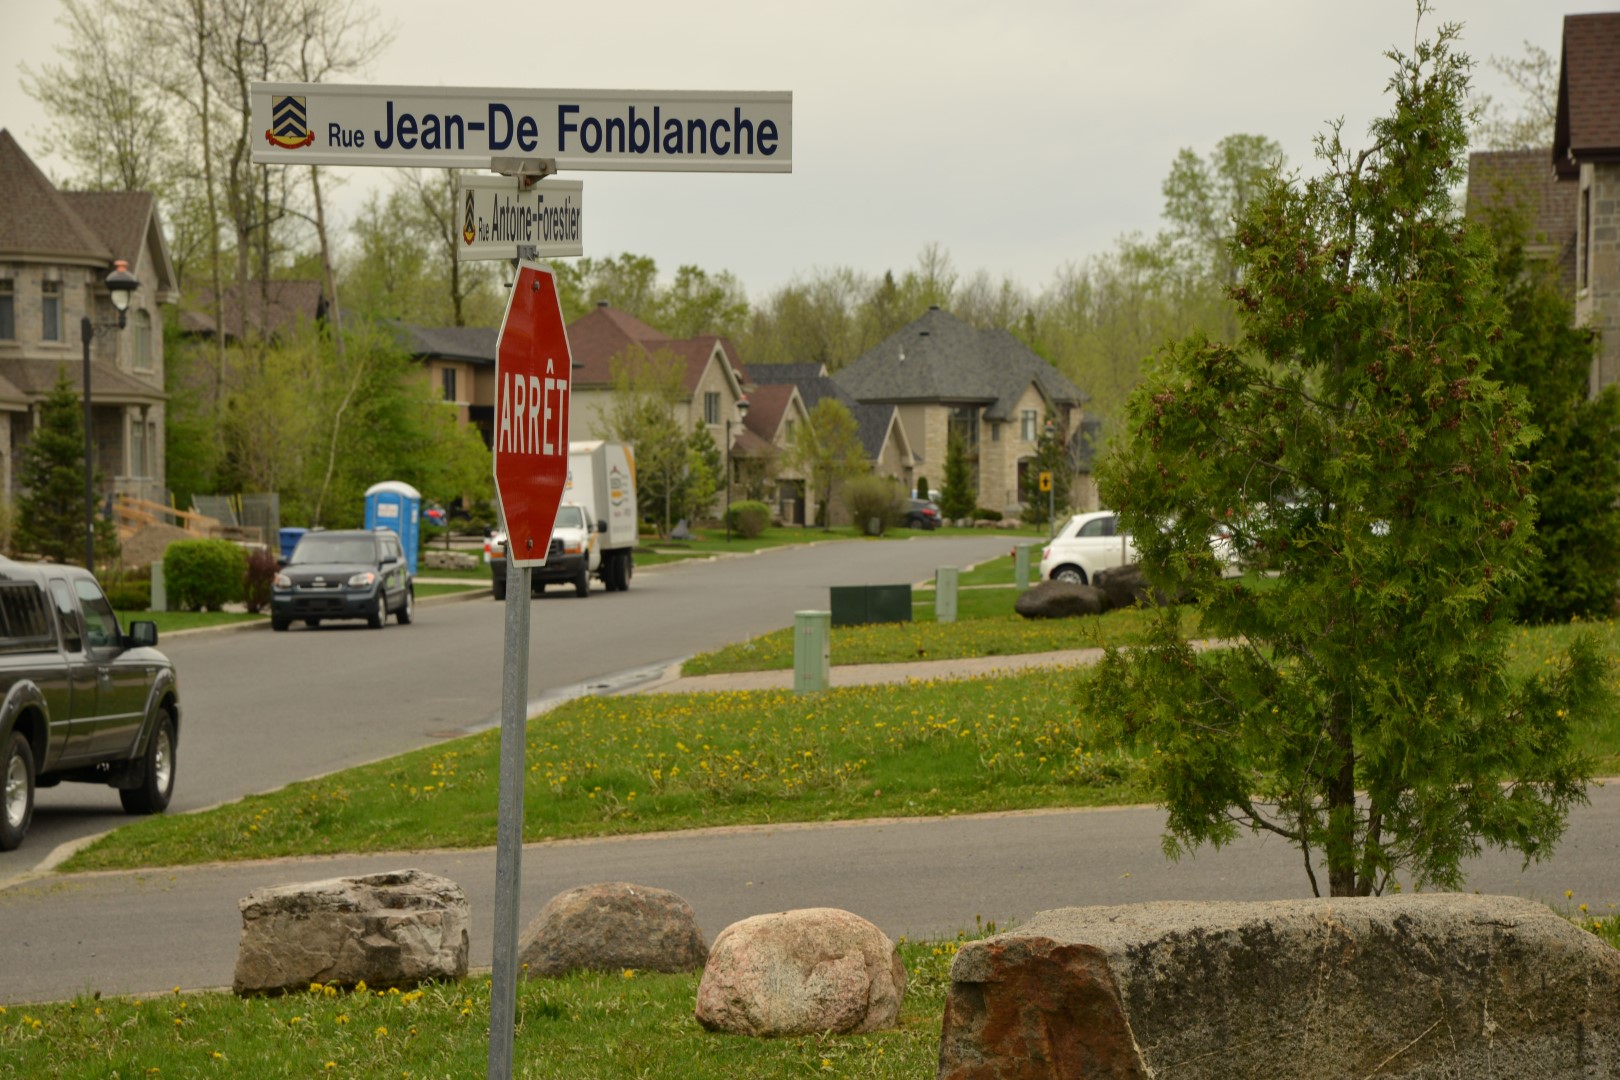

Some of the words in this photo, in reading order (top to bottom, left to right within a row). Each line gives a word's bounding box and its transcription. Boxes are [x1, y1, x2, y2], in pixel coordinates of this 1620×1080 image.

[328, 122, 365, 148] Rue
[374, 101, 538, 152] Jean-De
[558, 104, 779, 156] Fonblanche
[478, 216, 489, 242] Rue
[492, 193, 580, 242] Antoine-Forestier
[499, 358, 568, 456] ARRÊT
